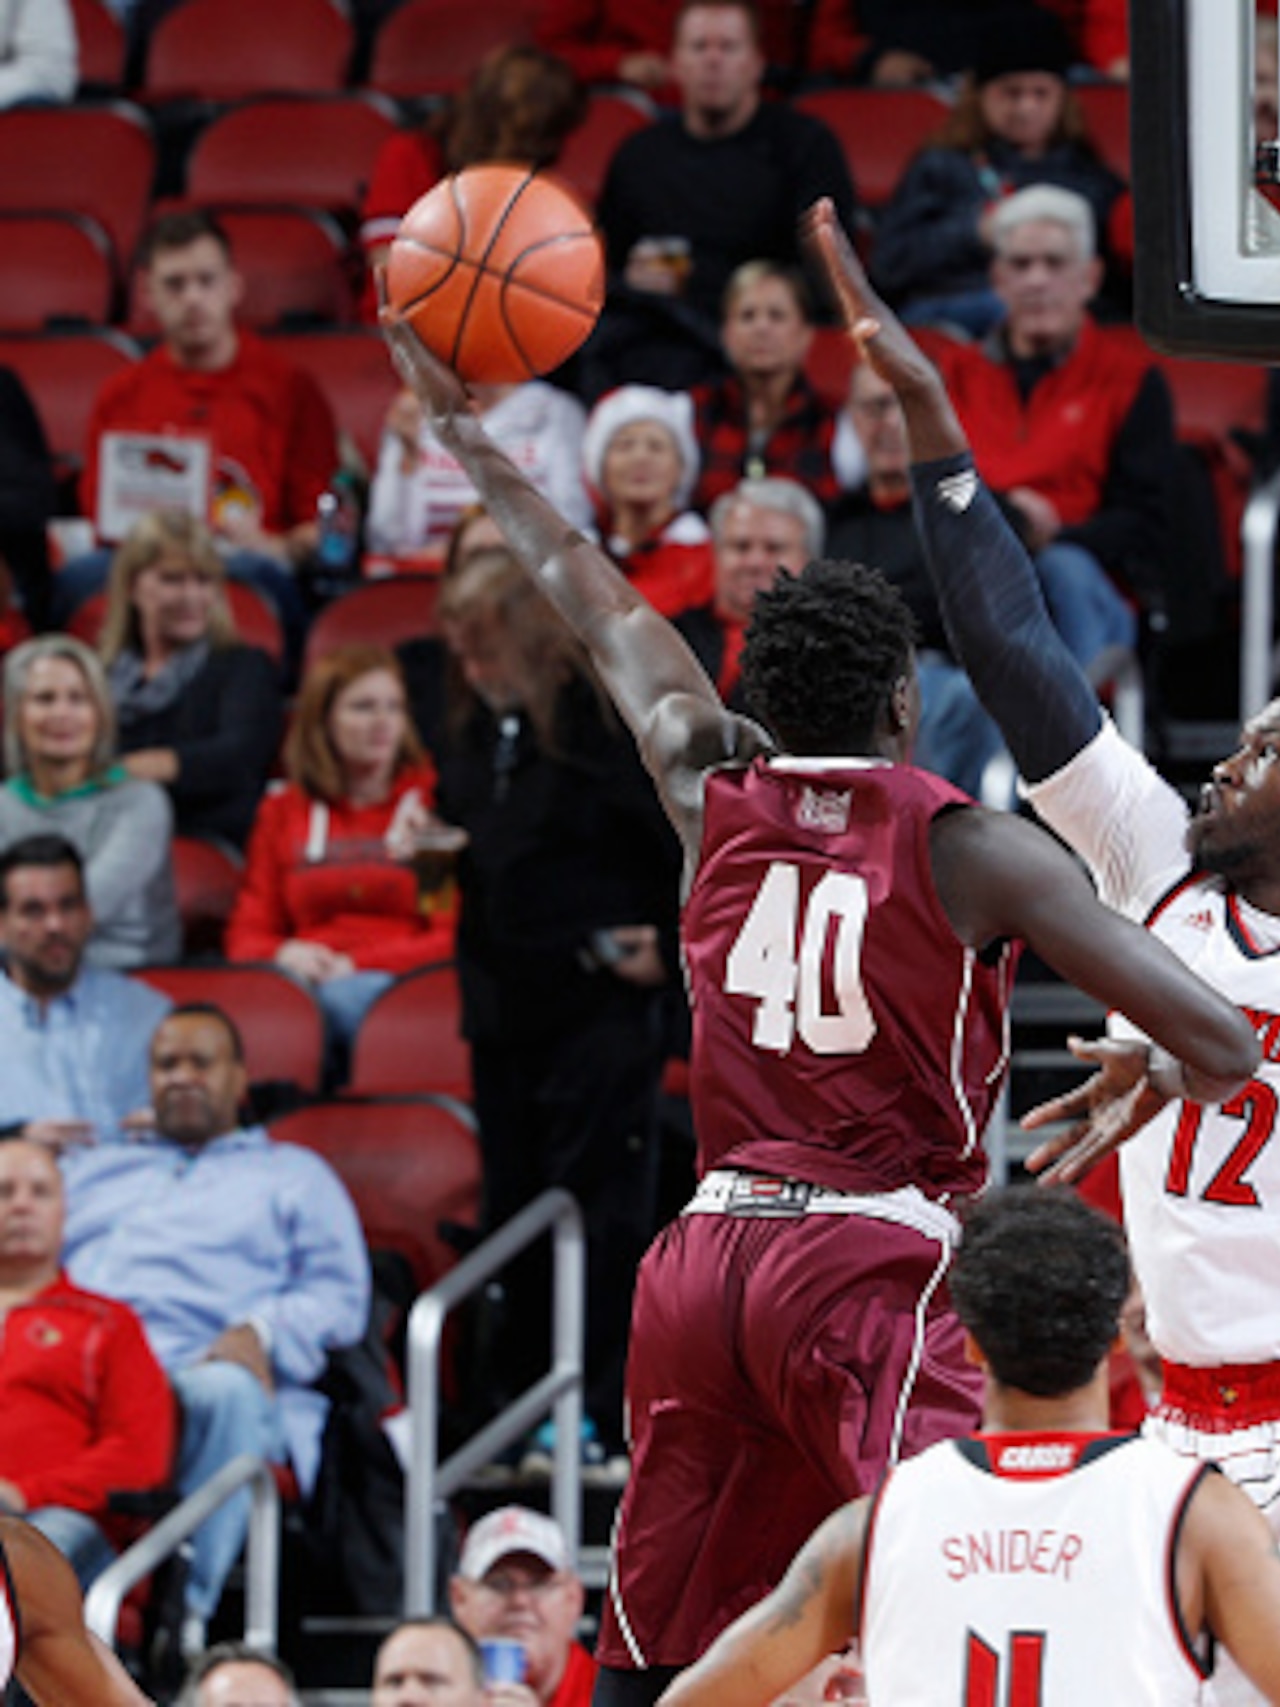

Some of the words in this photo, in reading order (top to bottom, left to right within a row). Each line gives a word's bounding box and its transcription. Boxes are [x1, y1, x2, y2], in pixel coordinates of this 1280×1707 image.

[724, 861, 878, 1056] 40
[1165, 1078, 1279, 1208] 12
[941, 1529, 1083, 1583] SNIDER
[962, 1621, 1048, 1707] 11
